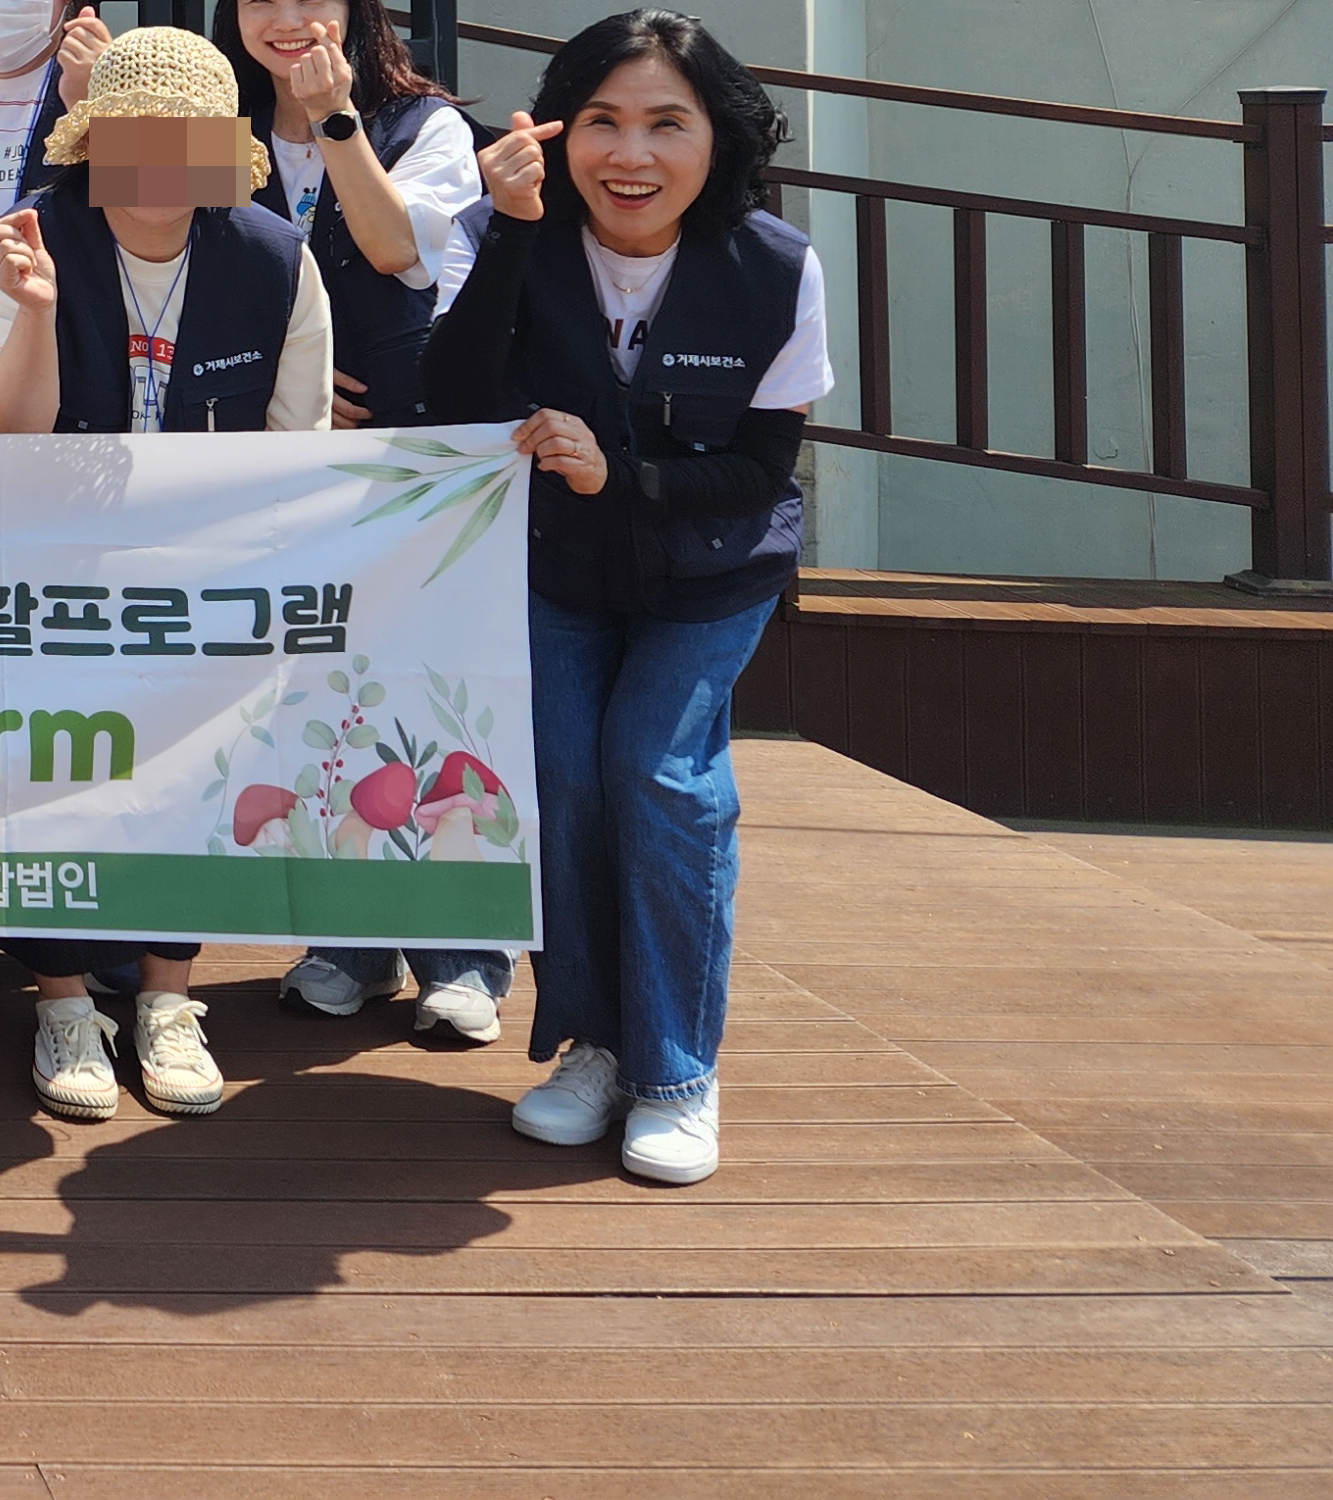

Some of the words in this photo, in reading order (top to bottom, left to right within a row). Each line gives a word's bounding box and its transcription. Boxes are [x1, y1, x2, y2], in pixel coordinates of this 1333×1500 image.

[130, 340, 149, 352] NO
[205, 350, 263, 371] 거제시보건소
[676, 354, 746, 369] 거제시보건소
